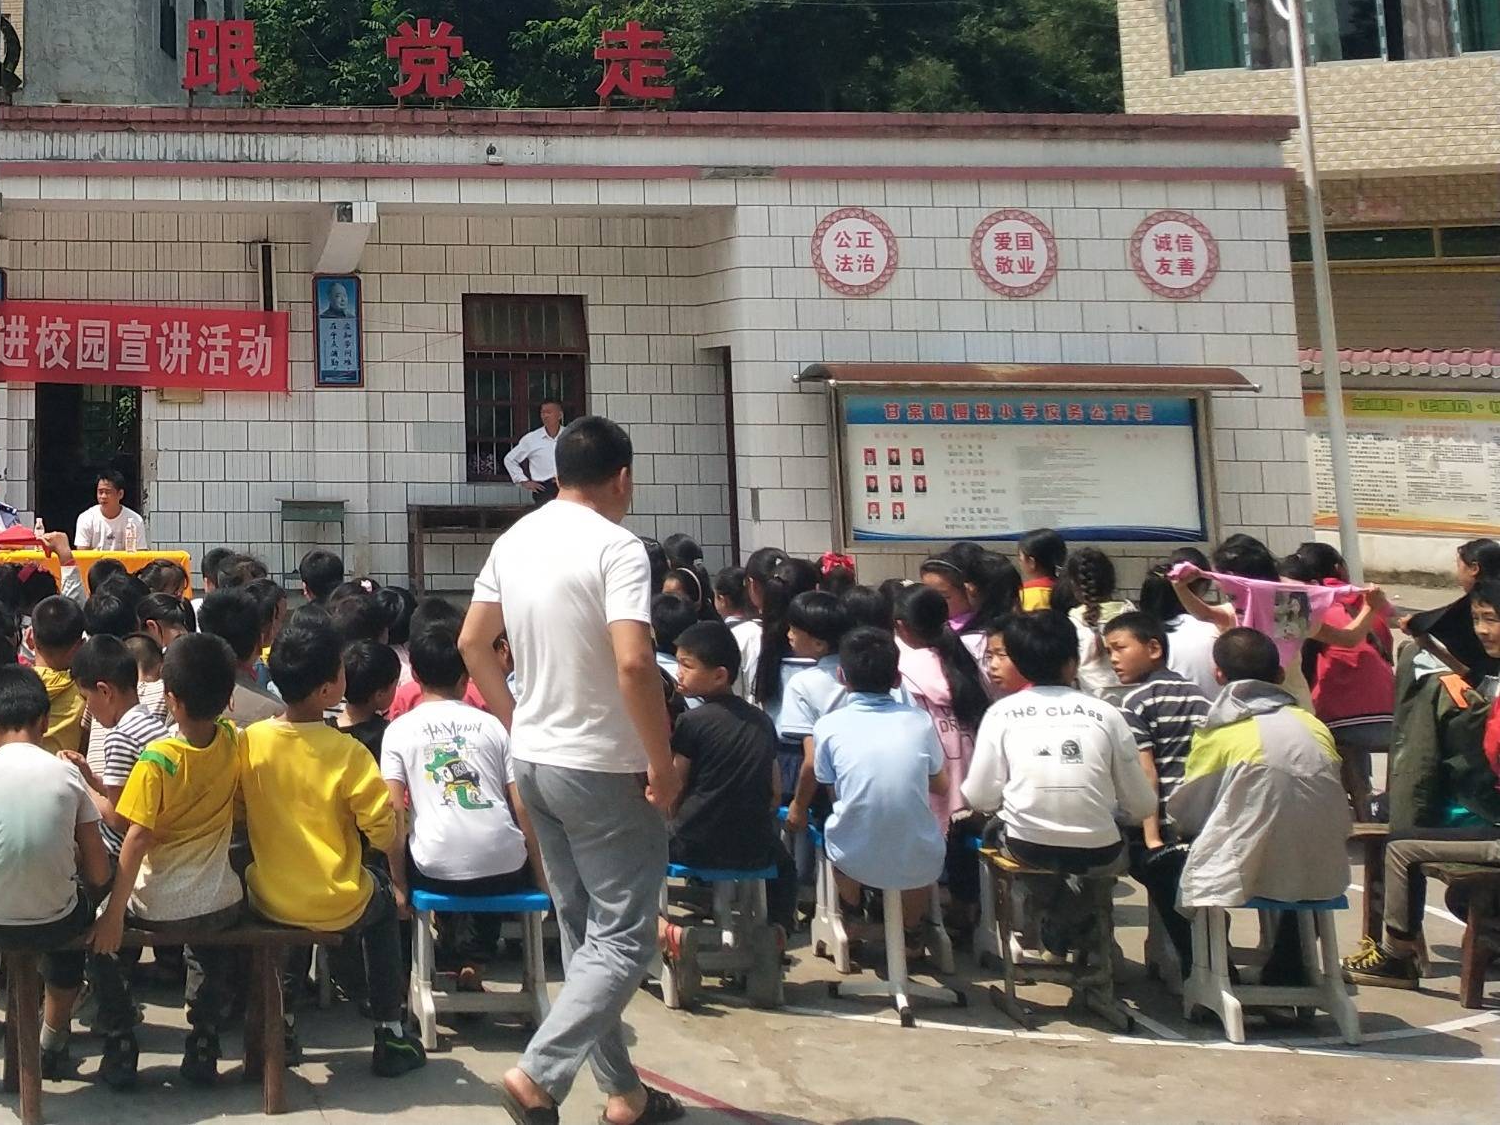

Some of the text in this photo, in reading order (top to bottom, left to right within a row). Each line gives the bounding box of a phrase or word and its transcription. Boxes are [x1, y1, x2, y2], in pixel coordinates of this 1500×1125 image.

[183, 19, 676, 99] 跟党走
[834, 231, 874, 249] 公正
[994, 231, 1034, 250] 爱国
[1153, 233, 1194, 253] 诚信
[835, 253, 876, 274] 法治
[995, 256, 1036, 275] 敬业
[1155, 256, 1196, 276] 友善
